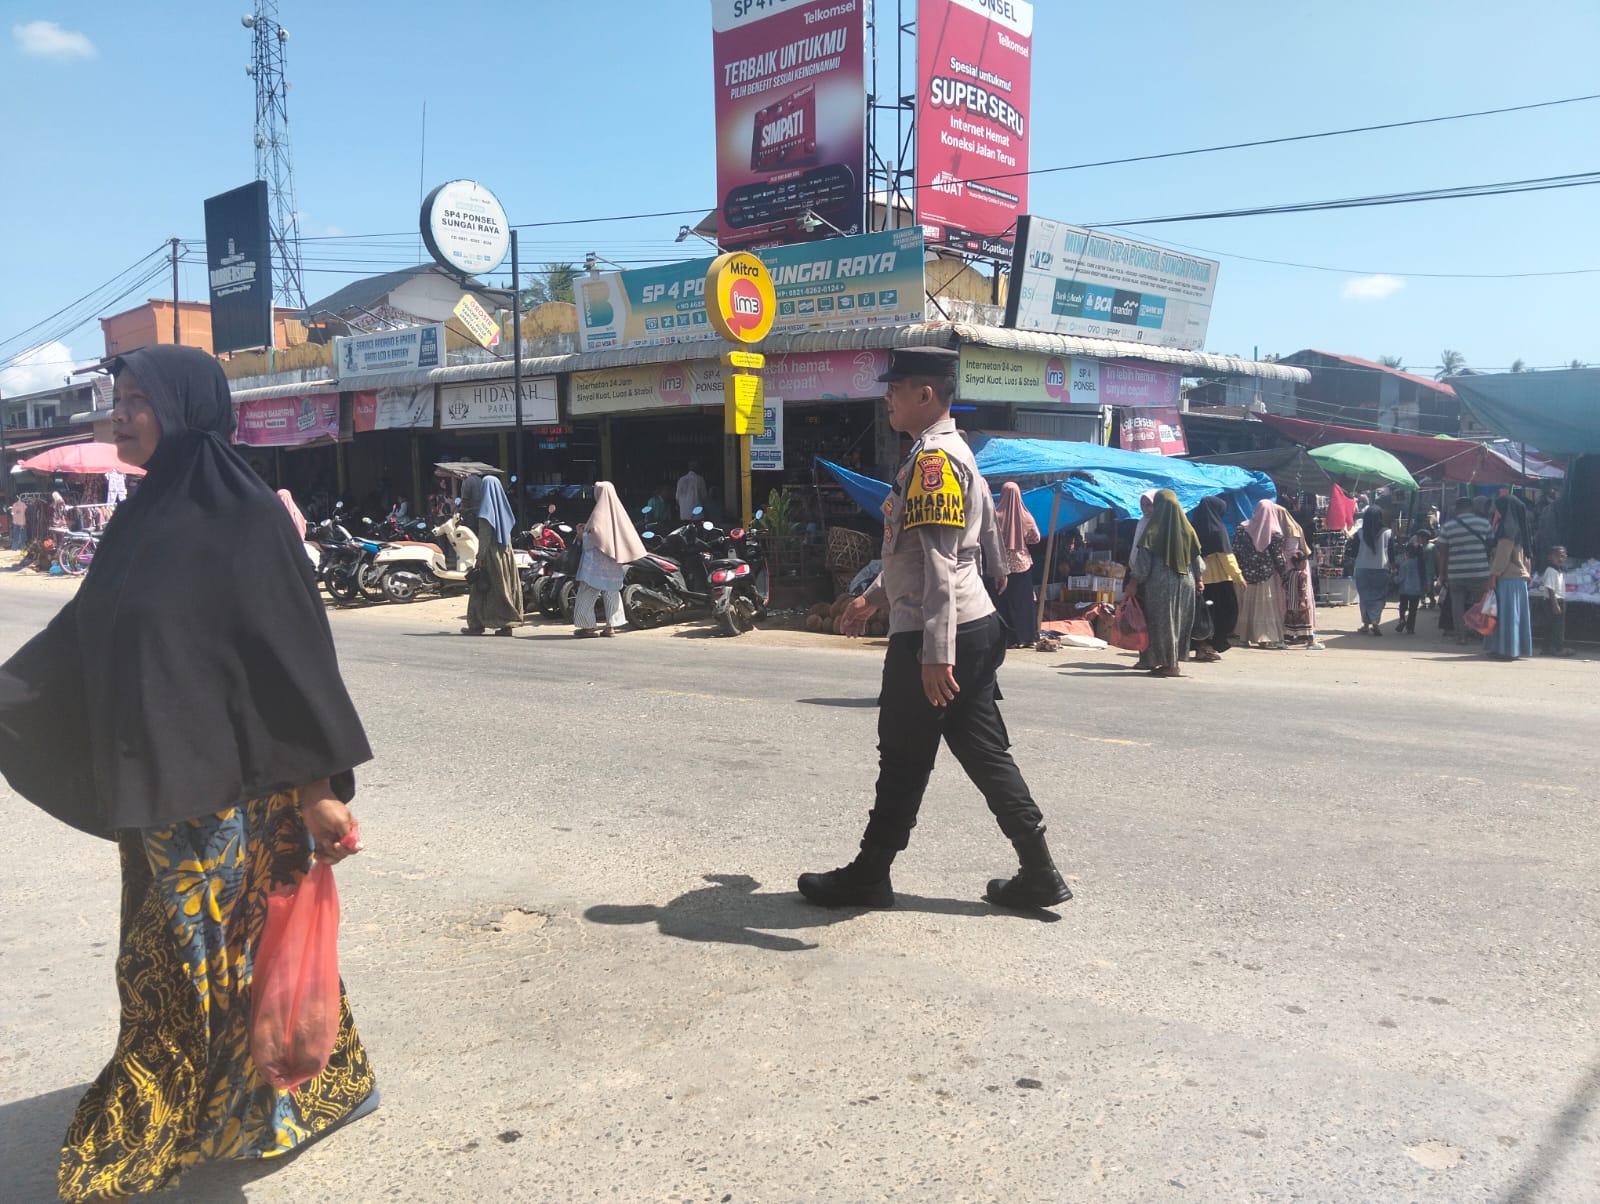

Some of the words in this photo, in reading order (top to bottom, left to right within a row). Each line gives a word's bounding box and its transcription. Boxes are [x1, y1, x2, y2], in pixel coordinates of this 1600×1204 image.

[803, 0, 856, 24] Telkomsel
[997, 32, 1029, 58] Telkomsel
[724, 49, 778, 86] TERBAIK
[780, 27, 848, 70] UNTUKMU
[950, 56, 978, 77] Spesial
[730, 85, 747, 100] PILIH
[747, 77, 773, 96] BENEFIT
[773, 70, 794, 88] SESUAI
[930, 77, 987, 114] SUPER
[988, 94, 1024, 136] SERU
[761, 109, 804, 147] SIMPATI
[950, 115, 984, 138] Internet
[985, 128, 1010, 147] Hemat
[941, 131, 975, 152] Koneksi
[975, 142, 996, 160] Jalan
[996, 149, 1016, 167] Terus
[441, 218, 476, 230] SUNGAI
[478, 224, 500, 234] RAYA
[463, 213, 497, 225] PONSEL
[730, 262, 759, 277] Mitra
[768, 260, 833, 286] UNGAI
[836, 251, 897, 278] RAYA
[642, 283, 665, 303] SP
[667, 281, 679, 300] 4
[734, 291, 759, 315] im3
[1093, 296, 1112, 312] BCA
[703, 370, 714, 379] SP
[966, 359, 1001, 371] Internetan
[1002, 361, 1010, 371] 24
[1010, 363, 1022, 372] Jam
[1047, 366, 1065, 385] im3
[1078, 368, 1087, 378] SP
[965, 374, 986, 386] Sinyal
[1005, 377, 1018, 386] Luas
[1023, 377, 1040, 387] Stabil
[1073, 381, 1097, 392] PONSEL
[634, 386, 653, 396] Stabil
[906, 493, 961, 512] BHABIN
